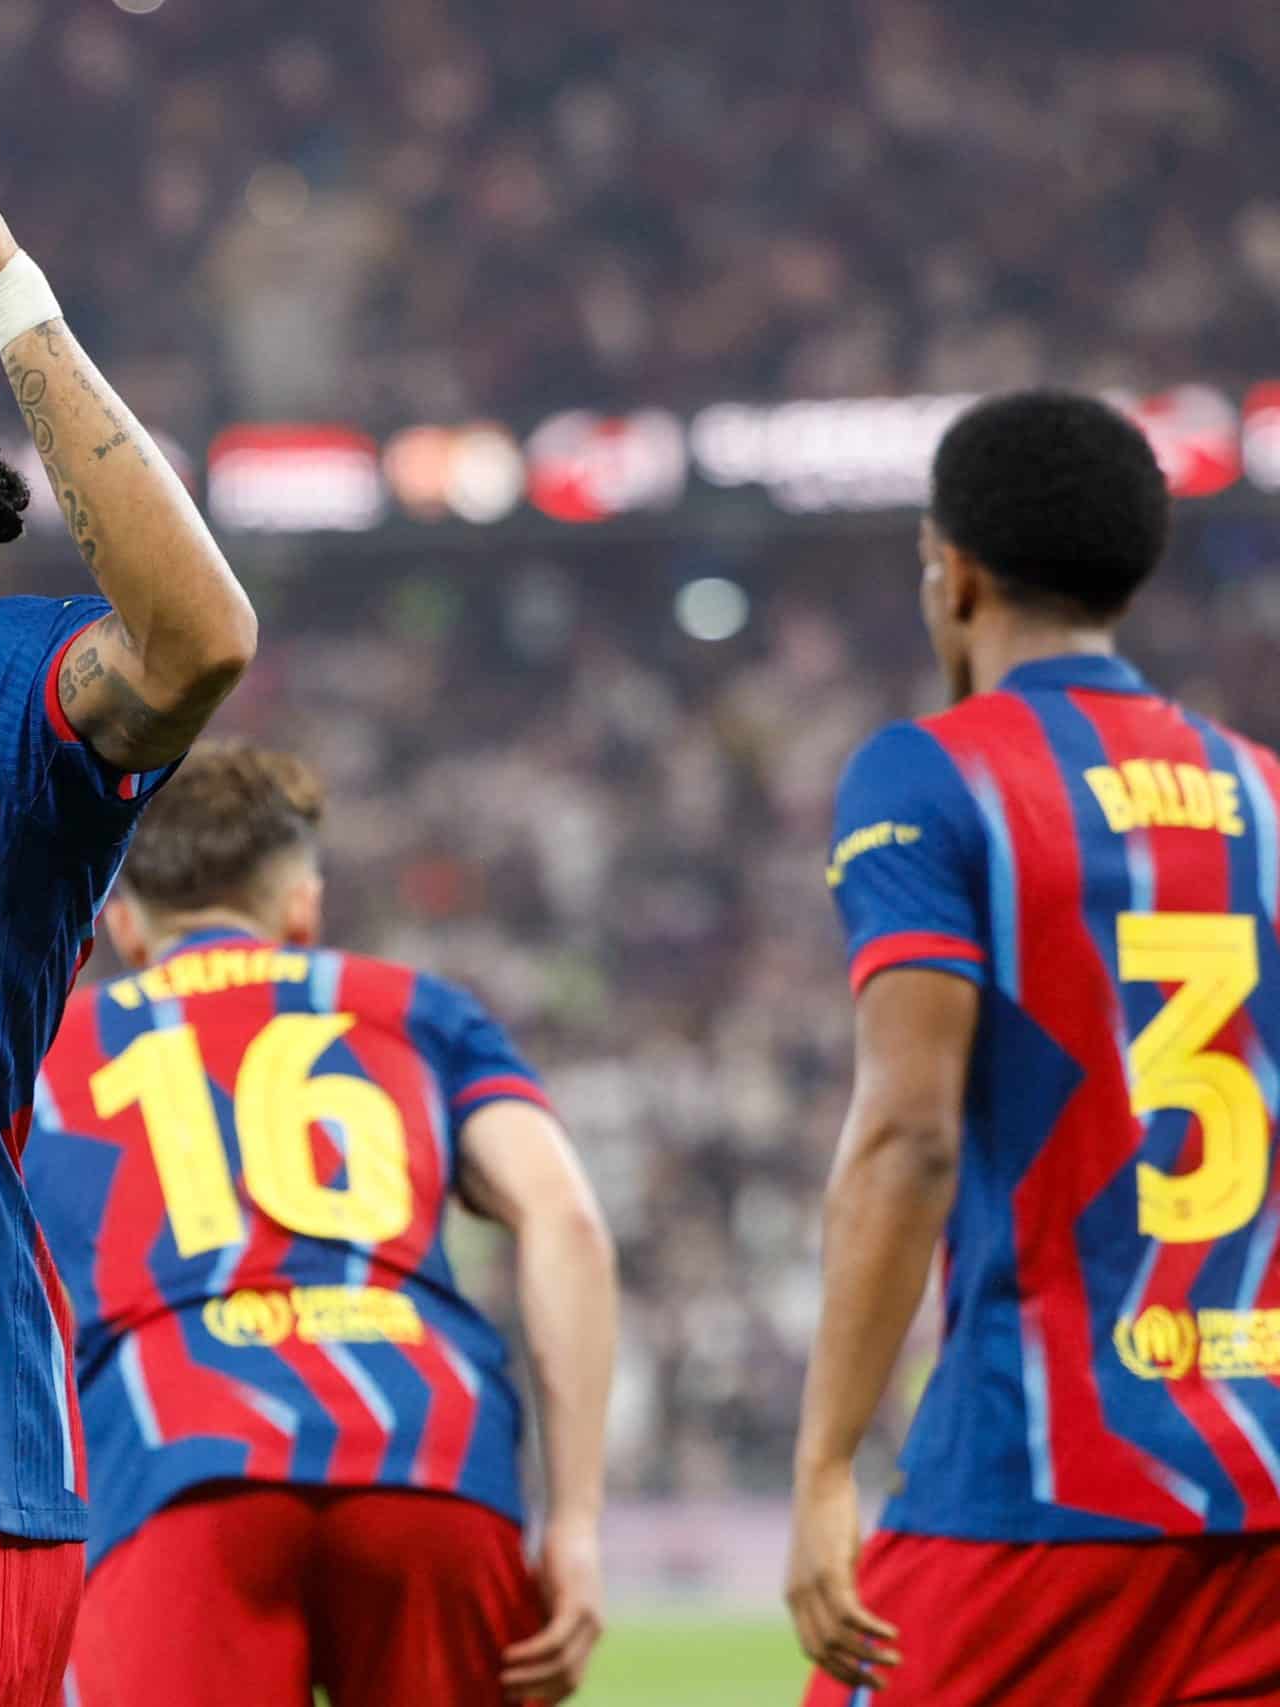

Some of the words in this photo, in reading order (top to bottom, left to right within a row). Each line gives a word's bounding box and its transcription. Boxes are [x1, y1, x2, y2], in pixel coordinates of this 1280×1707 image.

[1082, 757, 1247, 838] BALDE
[88, 1011, 415, 1260] 16
[1115, 911, 1272, 1244] 3
